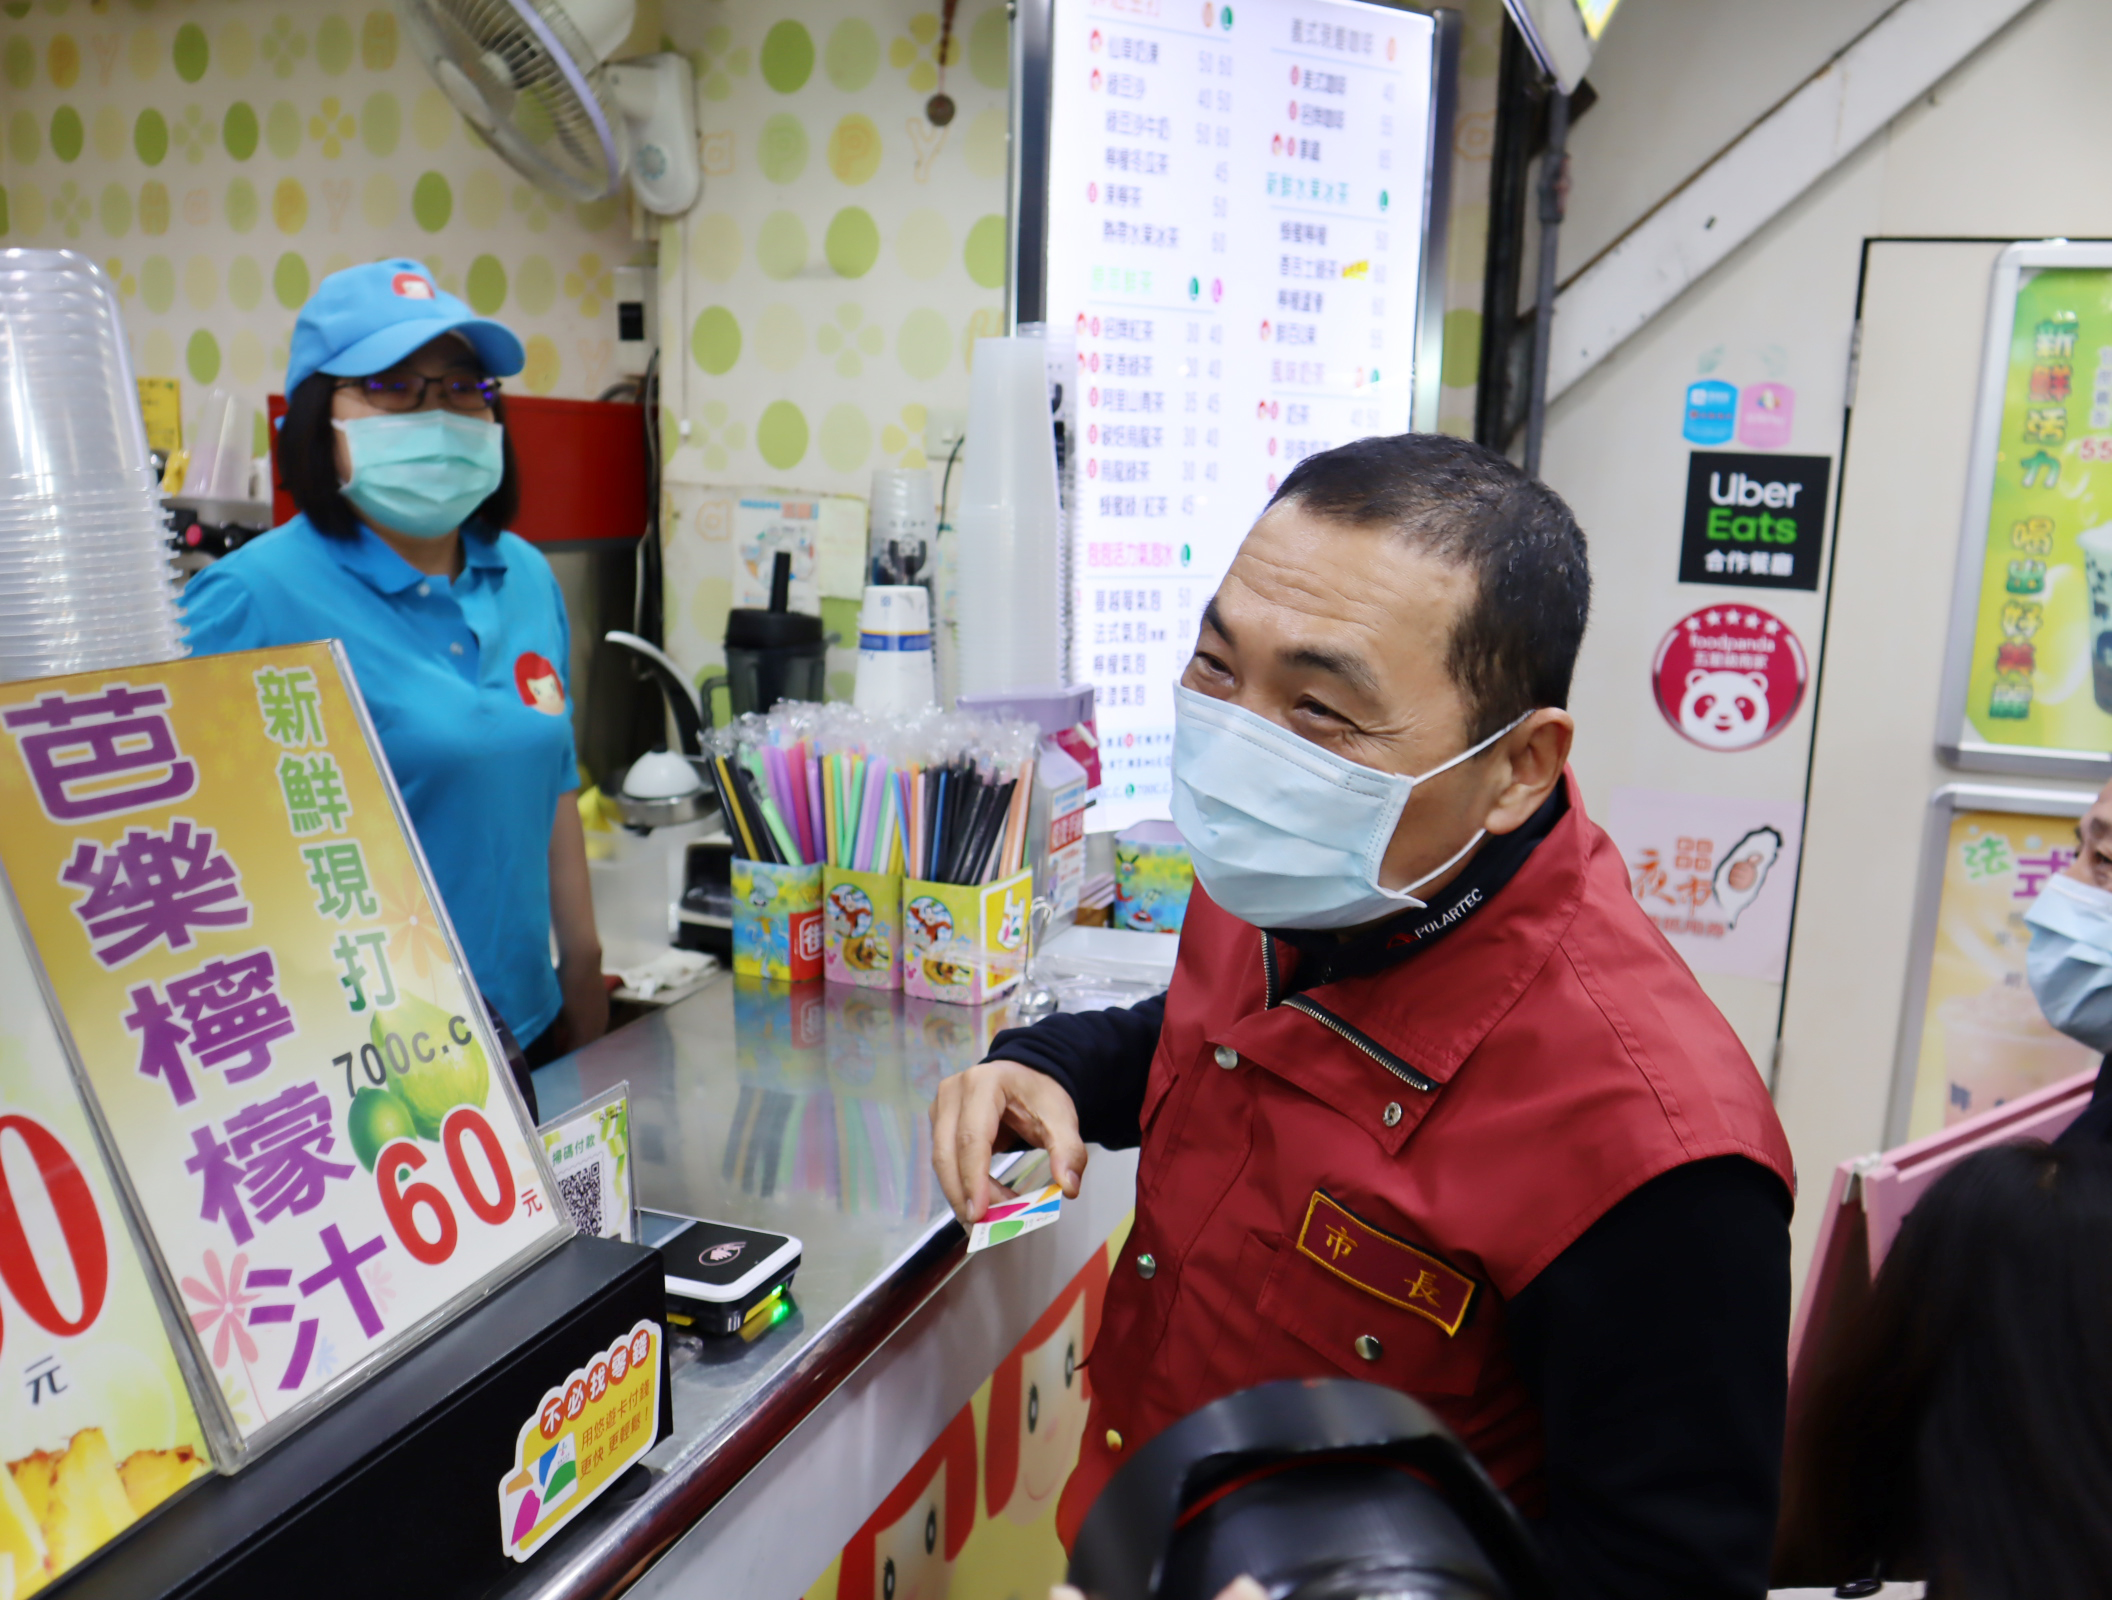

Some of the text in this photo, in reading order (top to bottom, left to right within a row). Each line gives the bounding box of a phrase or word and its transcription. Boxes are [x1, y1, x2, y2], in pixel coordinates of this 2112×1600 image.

[1709, 471, 1802, 509] Uber
[1705, 508, 1798, 544] Eats
[1688, 632, 1777, 654] foodpanda
[256, 666, 401, 1013] 新鮮現打
[1413, 886, 1484, 940] POLARTEC
[2, 685, 388, 1391] 芭樂檸檬汁
[552, 1132, 596, 1166] 掃碼付款
[373, 1107, 544, 1266] 60 元
[0, 1114, 108, 1356] 0
[25, 1354, 69, 1407] 元
[544, 1331, 649, 1435] 不必找零錢
[582, 1379, 650, 1452] 用悠遊卡付錢
[580, 1447, 605, 1481] 更快
